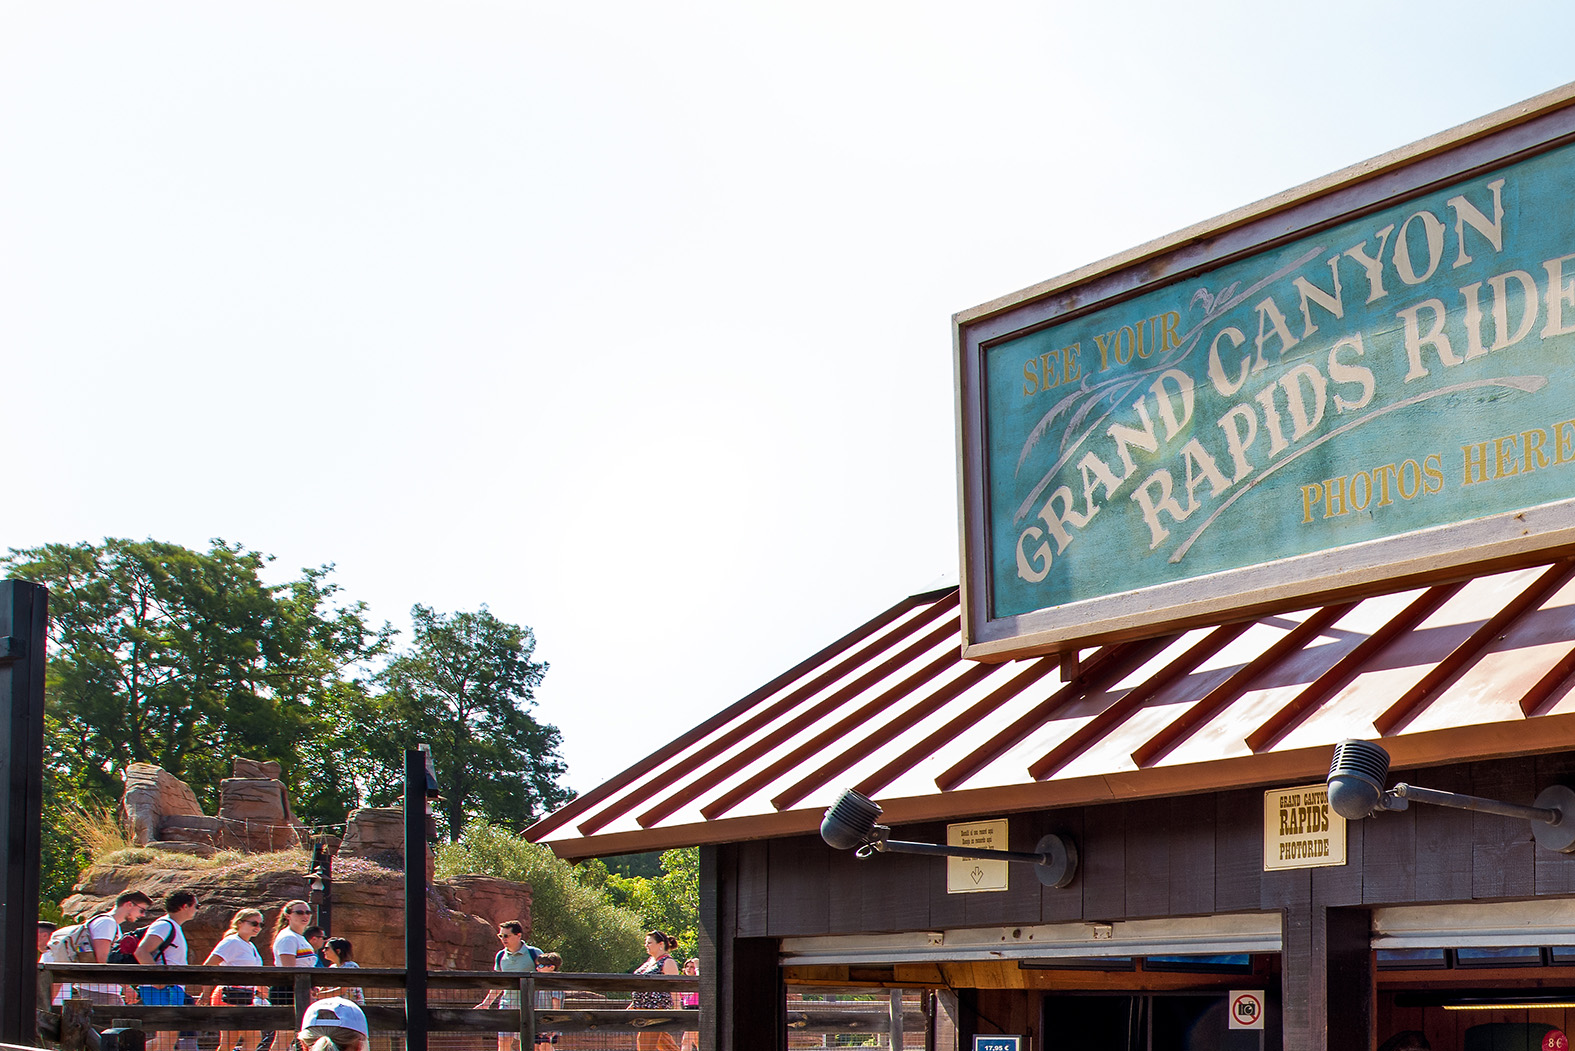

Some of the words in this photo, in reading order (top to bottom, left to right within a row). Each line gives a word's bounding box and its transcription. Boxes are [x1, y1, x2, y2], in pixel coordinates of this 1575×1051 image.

[1022, 344, 1082, 397] SEE
[1094, 311, 1183, 373] YOUR
[1015, 368, 1195, 583] GRAND
[1208, 178, 1507, 398] CANYON
[1130, 332, 1376, 550] RAPIDS
[1300, 455, 1446, 524] PHOTOS
[1279, 804, 1329, 836] RAPIDS
[1280, 794, 1301, 808] GRAND
[1304, 791, 1329, 806] CANYON
[1279, 838, 1330, 861] PHOTORIDE
[1548, 1038, 1555, 1048] 8
[1556, 1038, 1563, 1048] €
